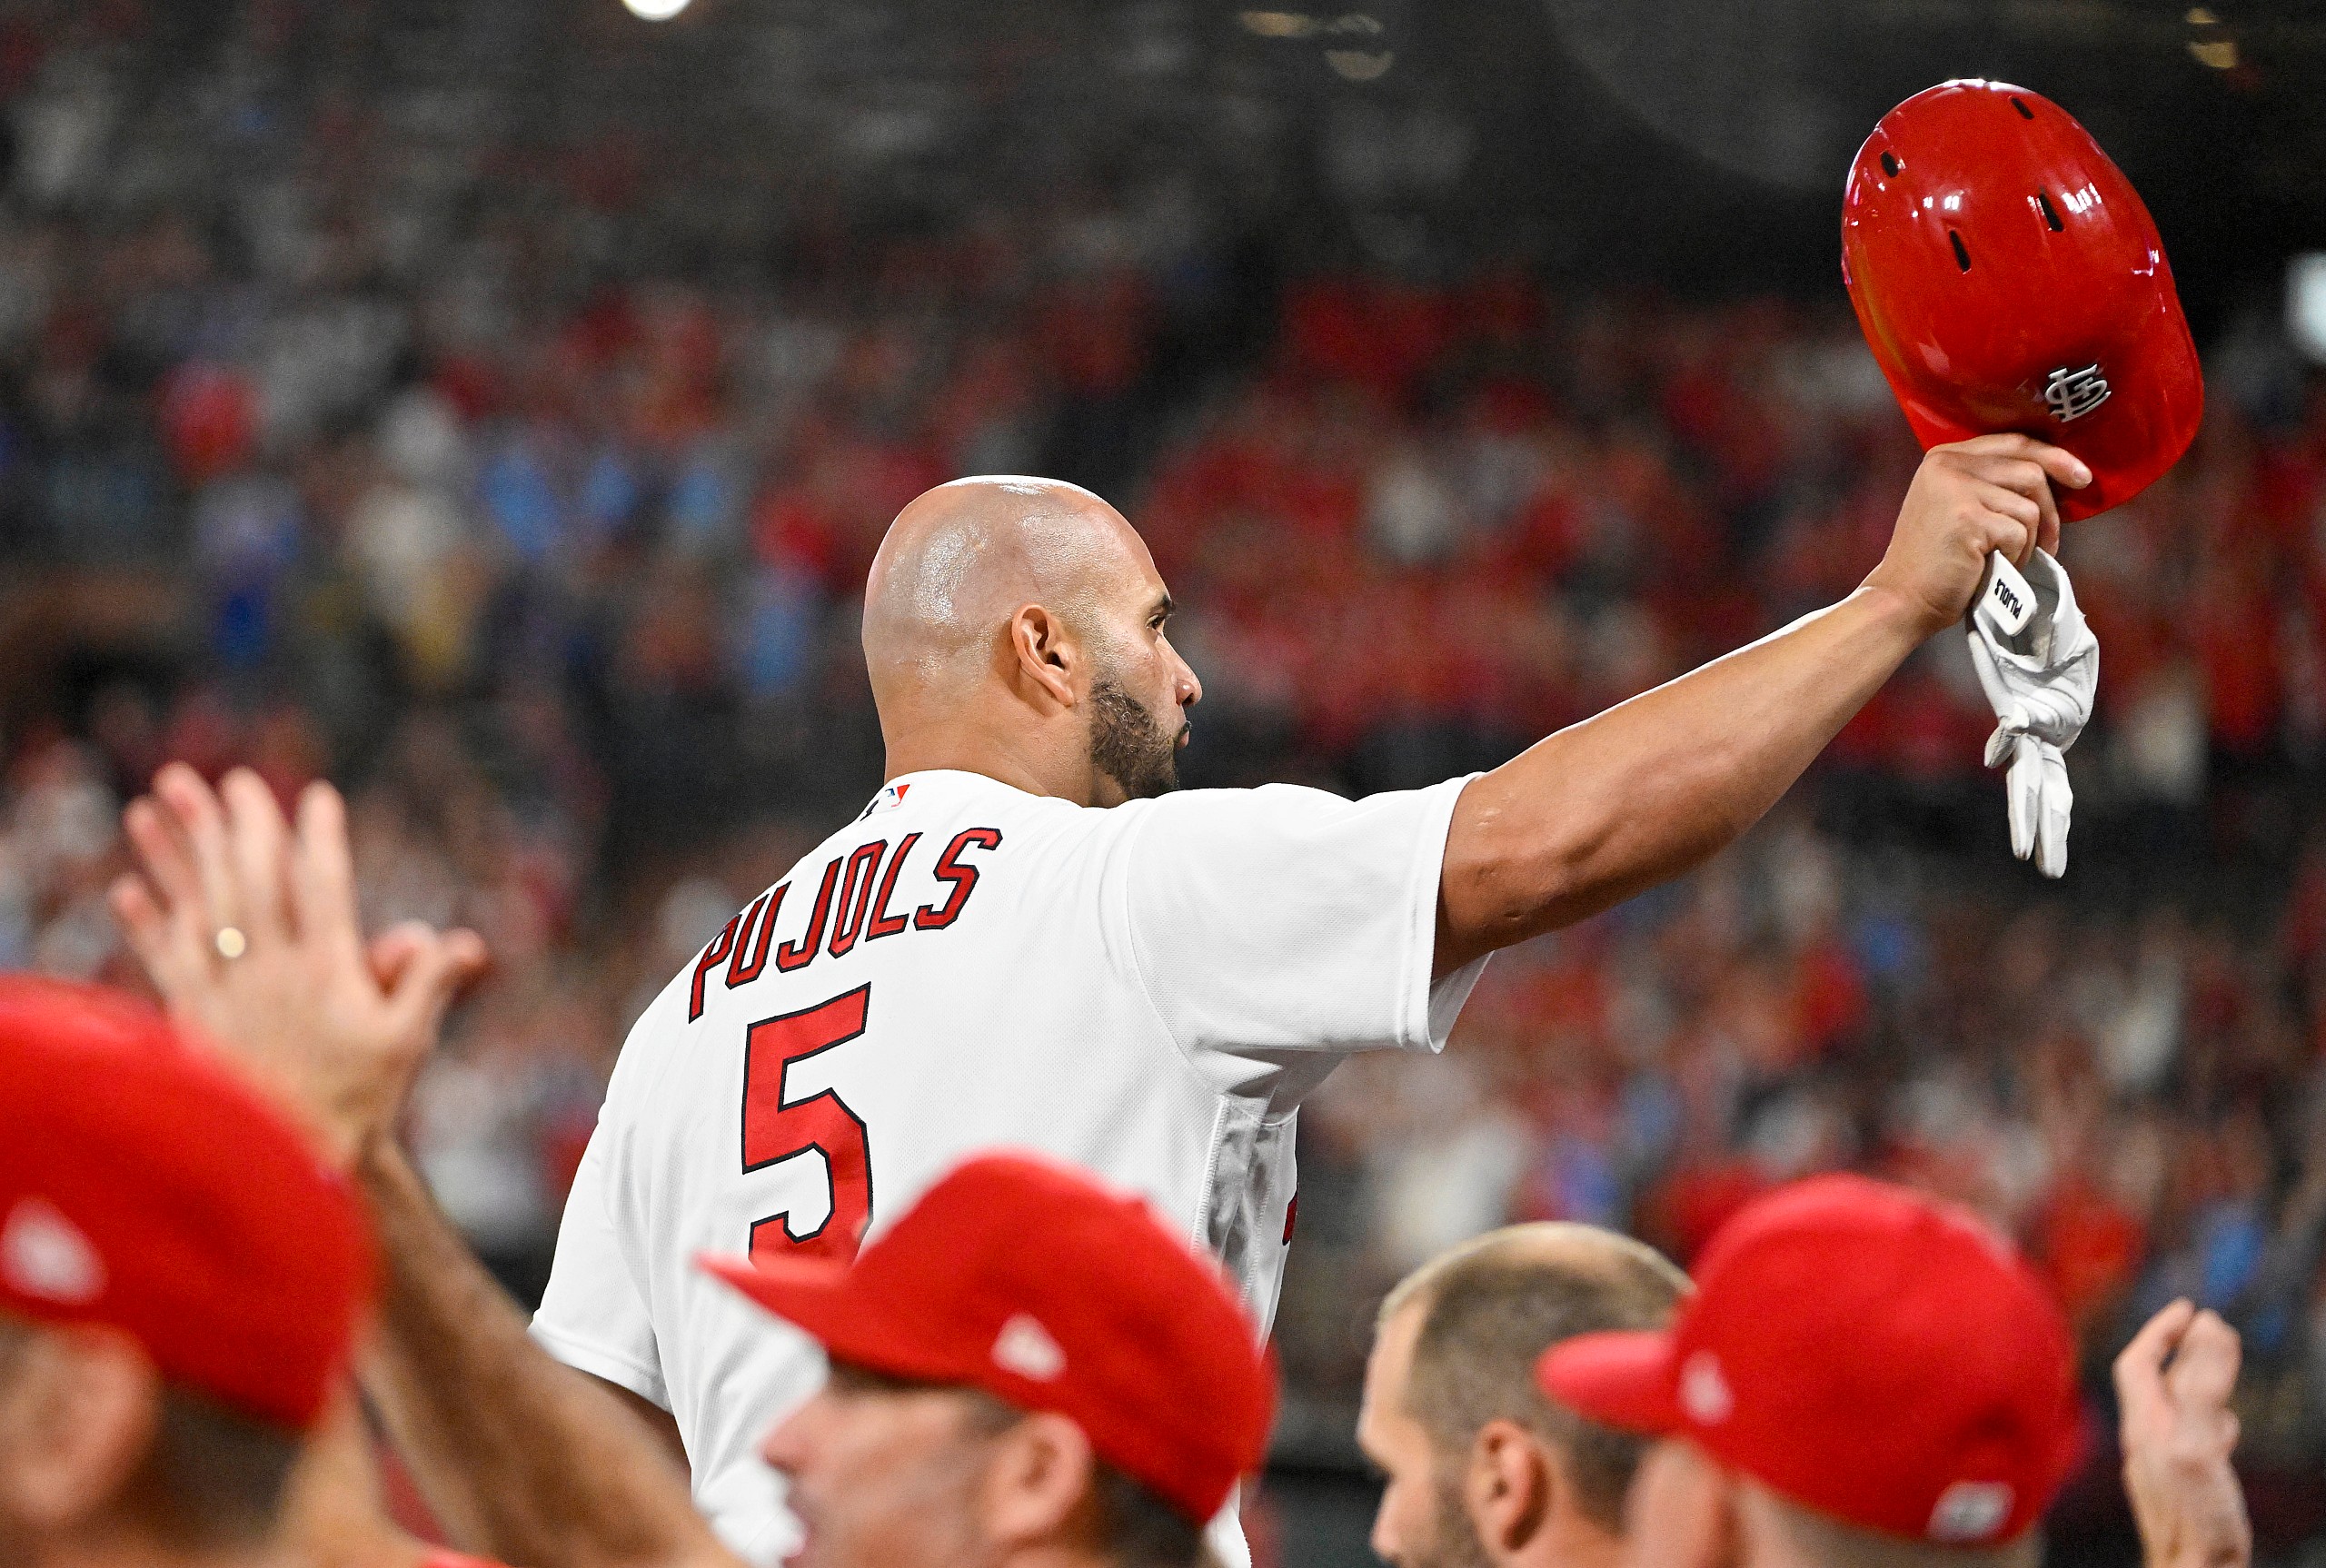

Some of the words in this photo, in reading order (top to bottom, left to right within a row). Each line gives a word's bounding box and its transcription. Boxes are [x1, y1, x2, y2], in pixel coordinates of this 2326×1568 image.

[1994, 578, 2023, 620] PUJOLS
[689, 828, 1002, 1024] PUJOLS
[741, 981, 874, 1270] 5
